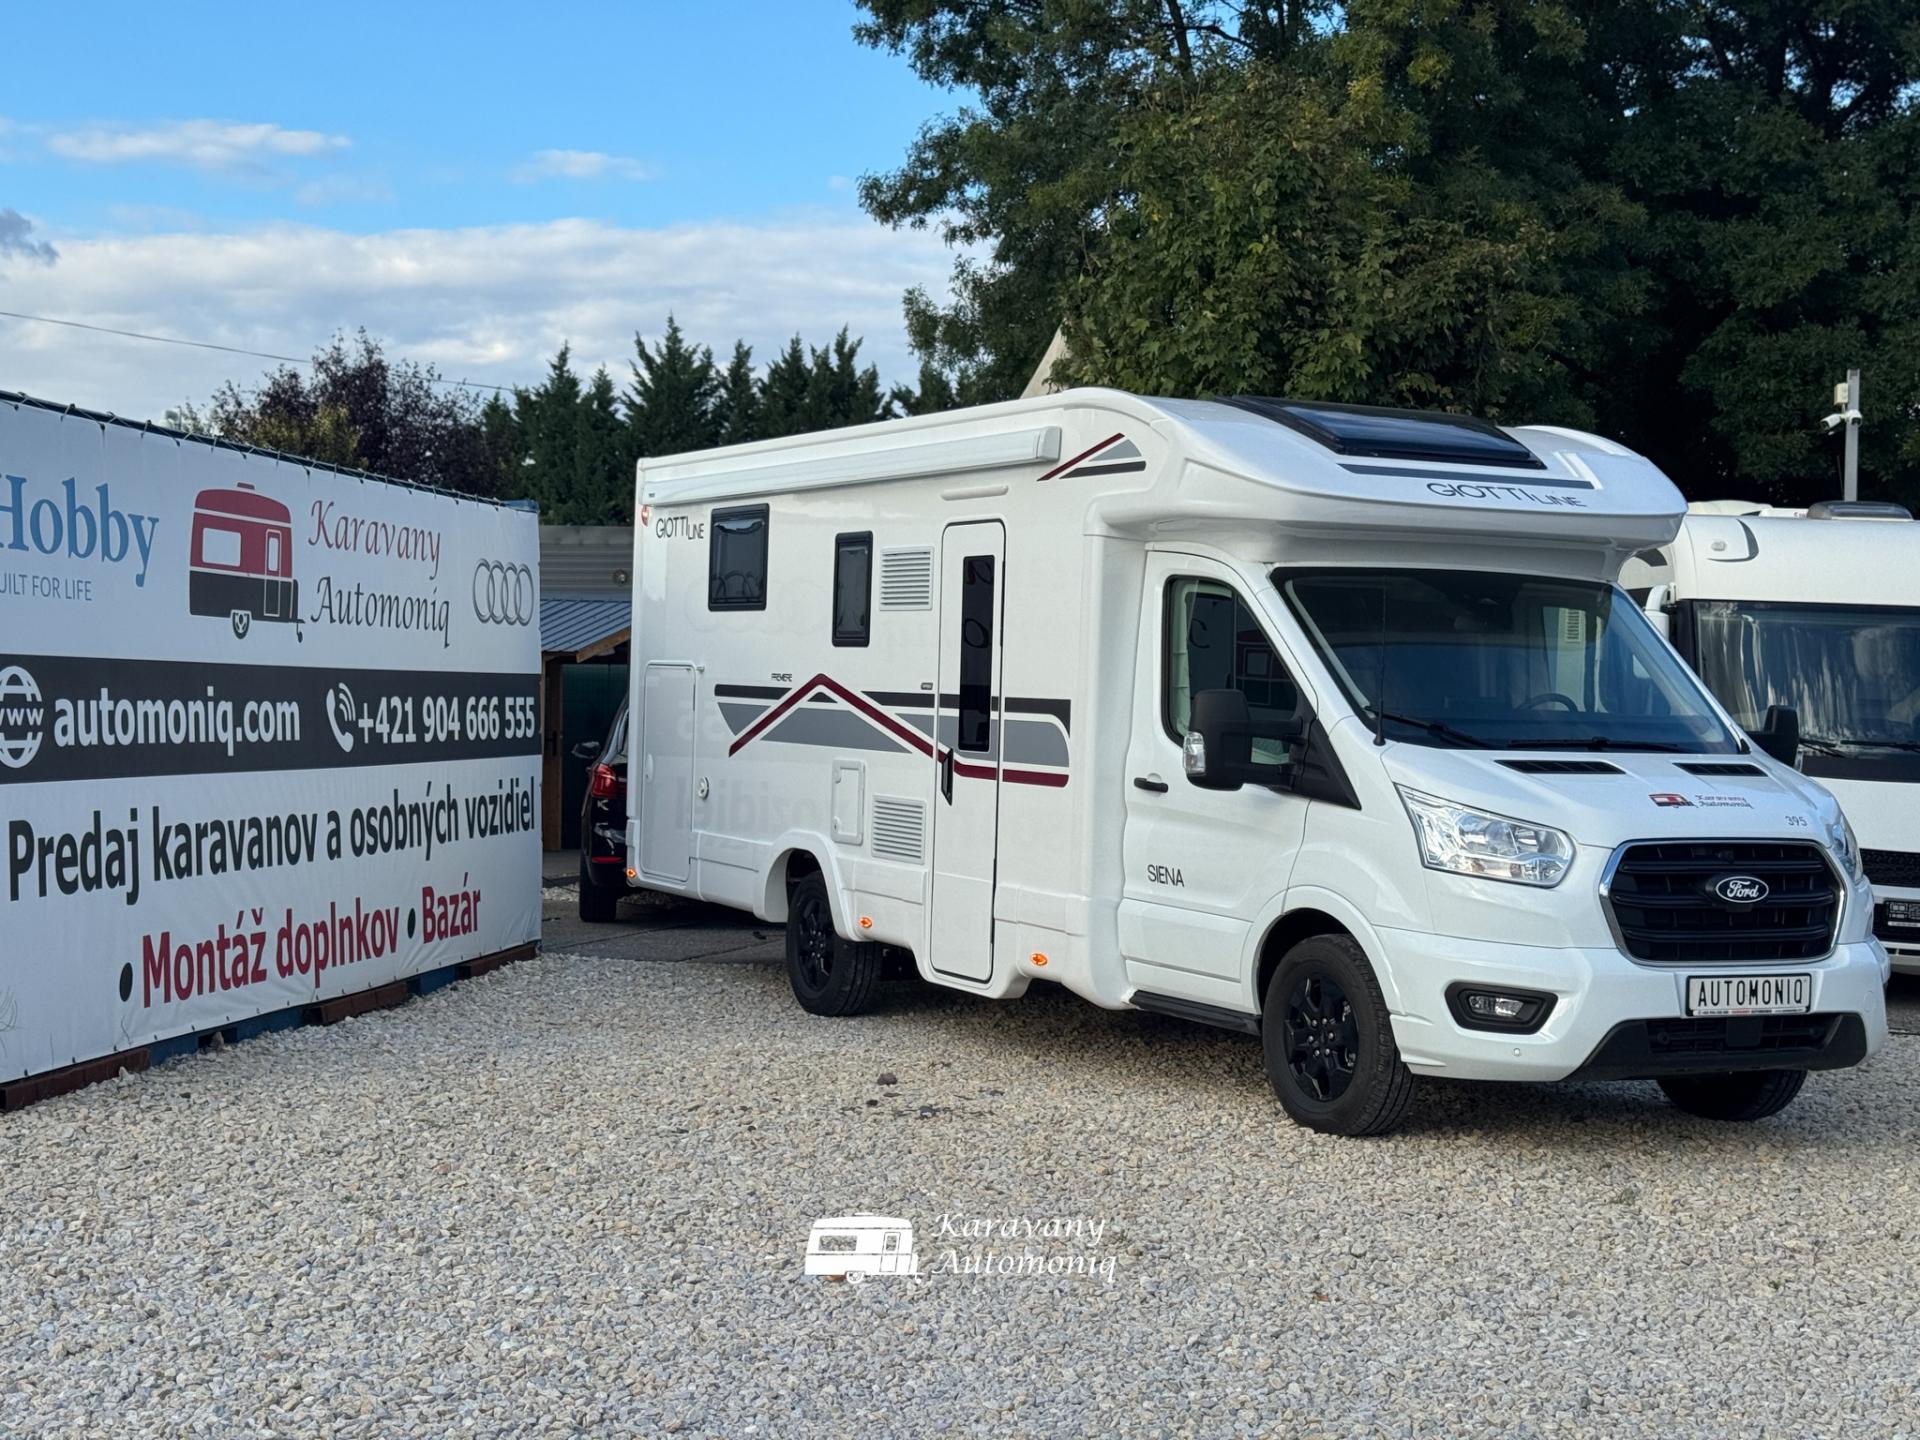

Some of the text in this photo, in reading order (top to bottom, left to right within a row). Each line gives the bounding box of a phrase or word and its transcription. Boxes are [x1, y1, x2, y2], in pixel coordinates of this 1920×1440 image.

[0, 473, 160, 588] Hobby
[308, 499, 441, 580] Karavany
[0, 573, 93, 601] UILT FOR LIFE
[310, 575, 450, 649] Automoniq
[54, 686, 301, 757] automoniq.com
[358, 696, 535, 745] +421 904 666 555
[8, 776, 535, 906] Predaj karavanov a osobných vozidiel
[1785, 815, 1808, 827] 395
[1147, 864, 1185, 888] SIENA
[1726, 880, 1759, 898] Ford
[142, 871, 481, 1009] Montáž doplnkov Bazár
